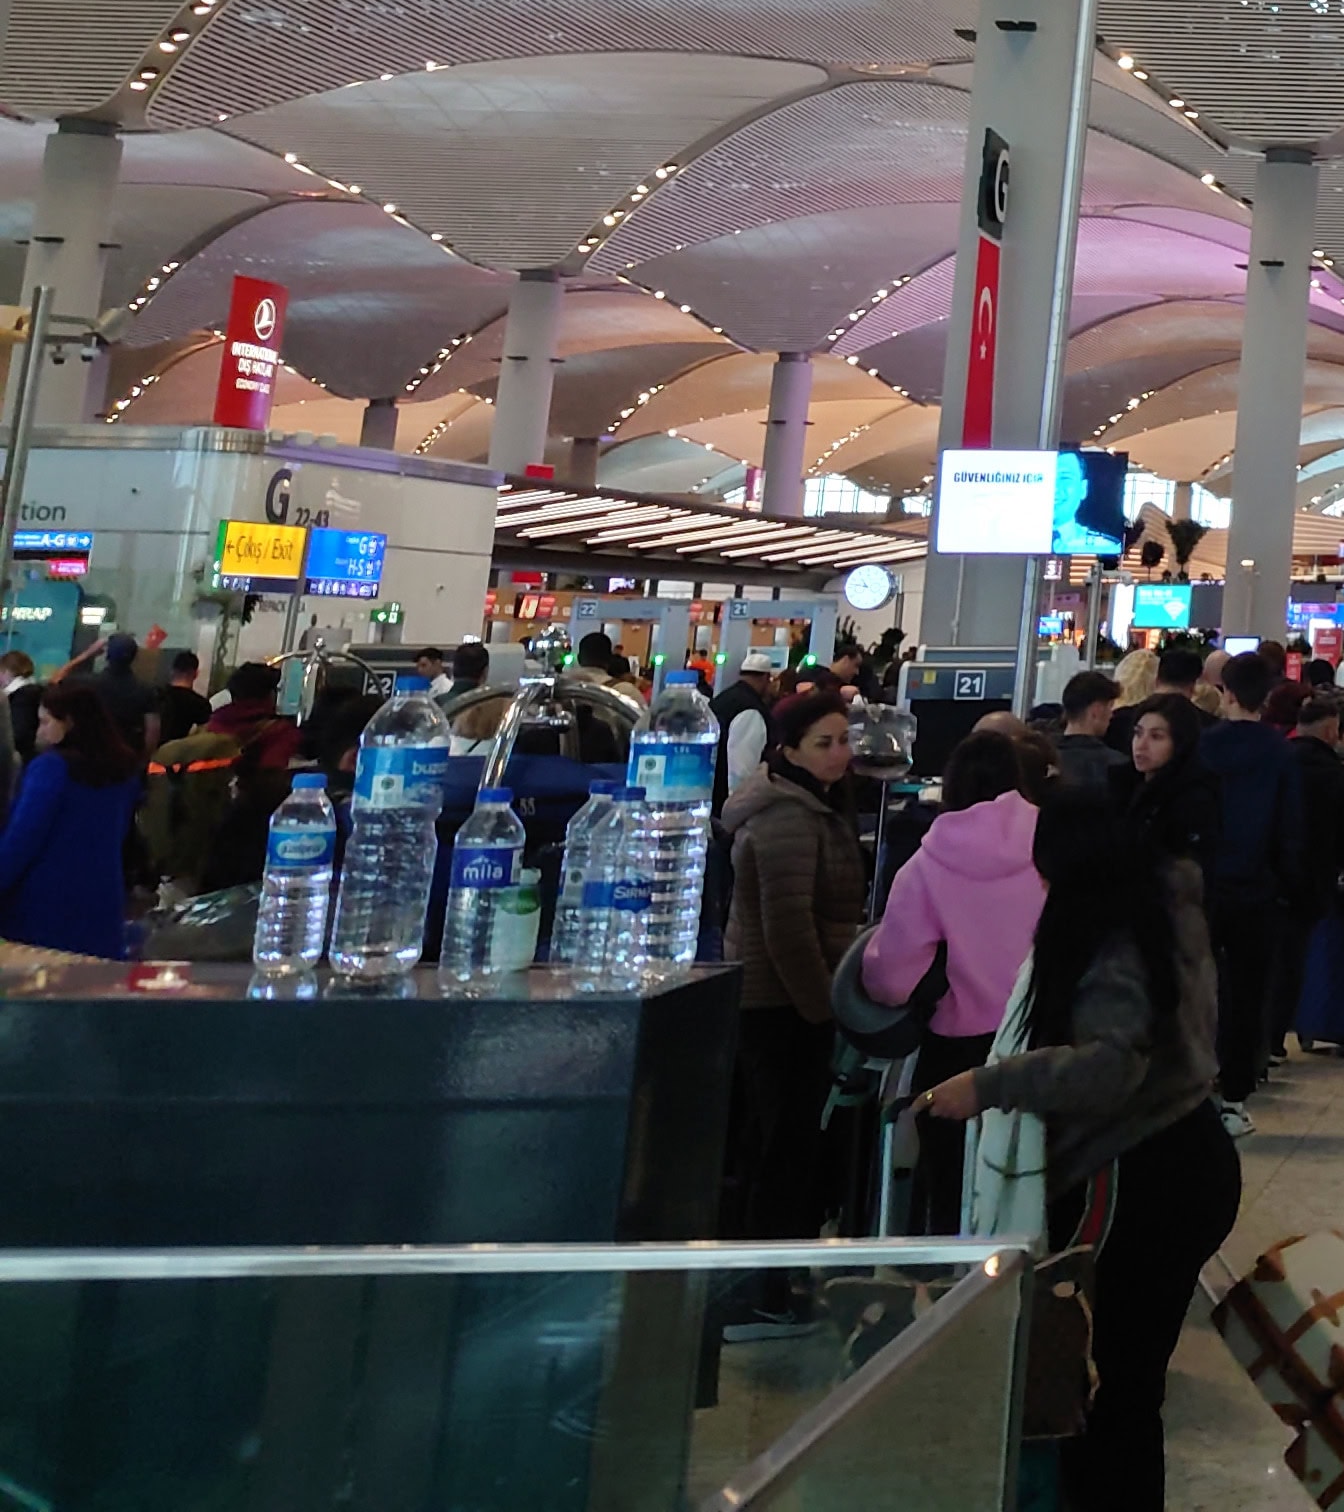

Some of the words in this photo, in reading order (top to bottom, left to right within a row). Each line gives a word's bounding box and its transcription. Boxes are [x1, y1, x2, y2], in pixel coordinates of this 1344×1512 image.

[995, 149, 1009, 223] G
[266, 468, 293, 524] G
[295, 508, 330, 527] 22-43
[41, 534, 66, 547] A-G
[272, 538, 293, 561] Exit
[359, 536, 369, 555] G
[580, 603, 596, 615] 22
[733, 603, 748, 616] 21
[959, 677, 981, 694] 21
[463, 863, 503, 881] mila
